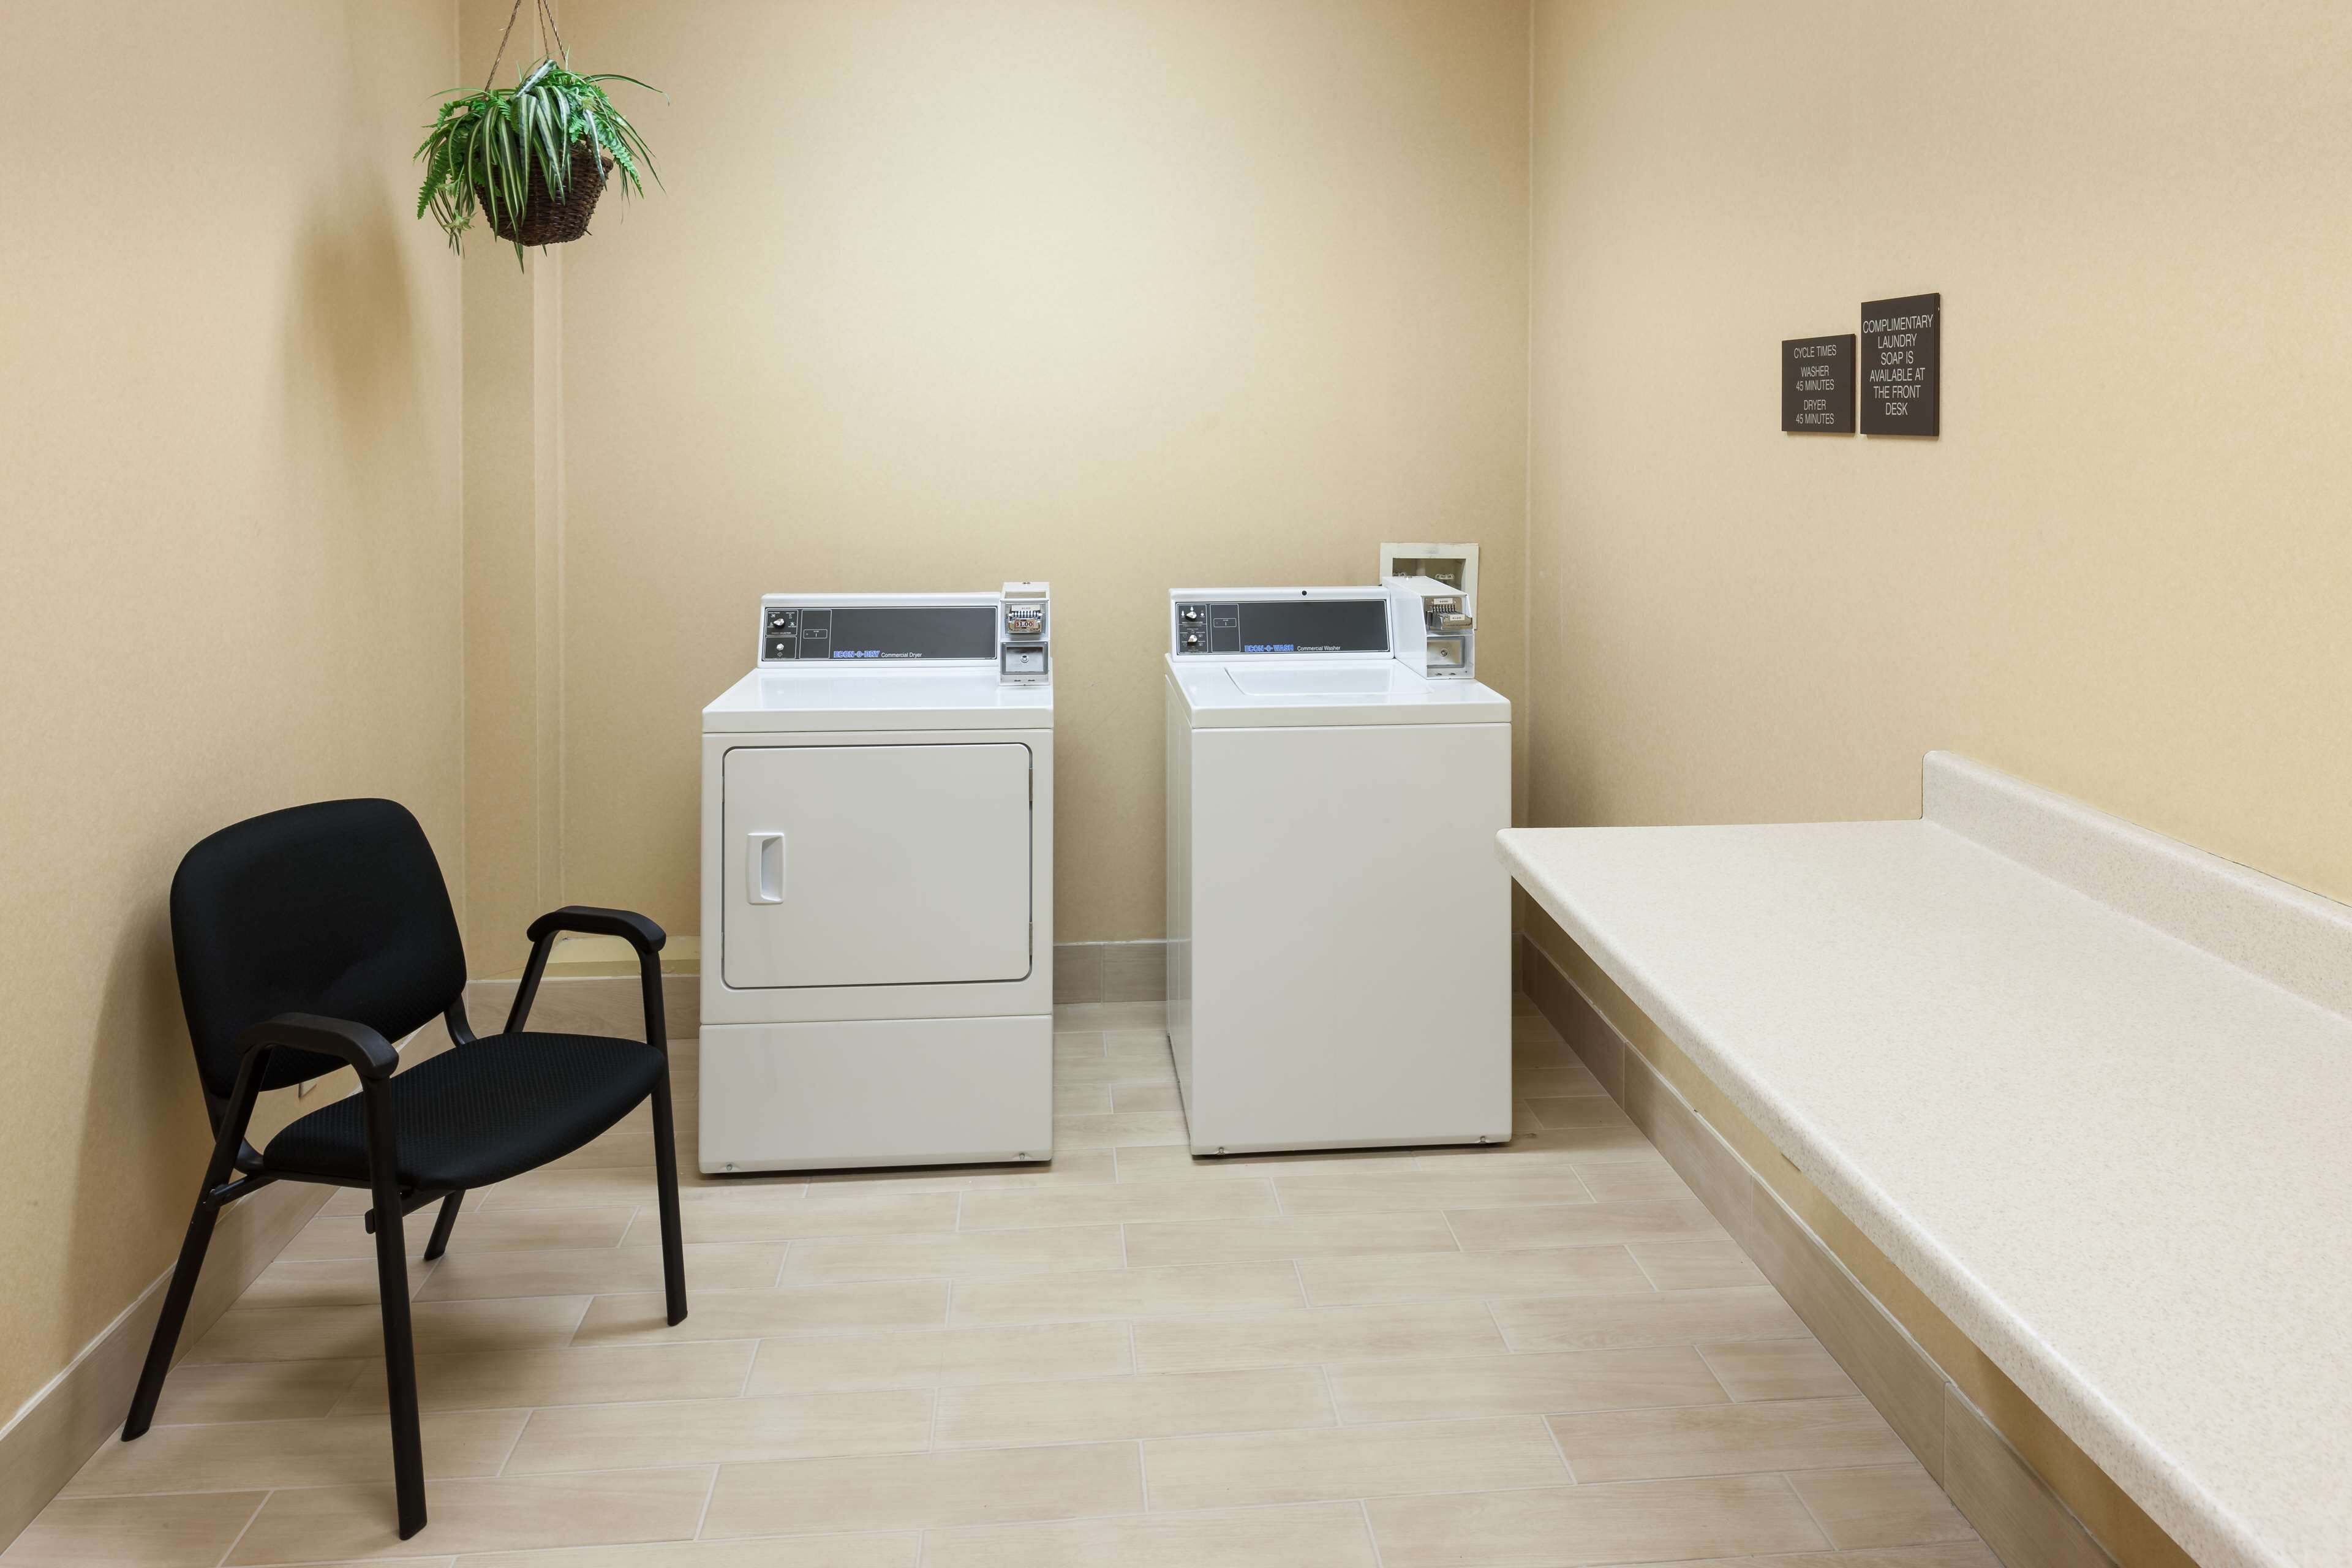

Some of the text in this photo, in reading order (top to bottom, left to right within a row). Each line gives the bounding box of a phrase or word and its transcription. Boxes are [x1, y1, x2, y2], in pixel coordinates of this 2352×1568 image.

[1863, 315, 1933, 333] COMPLIMENTARY
[1878, 334, 1917, 349] LAUNDRY
[1794, 344, 1837, 358] CYCLE TIMES
[1881, 351, 1913, 365] SOAP IS
[1801, 365, 1829, 377] WASHER
[1870, 368, 1926, 382] AVAILABLE AT
[1796, 379, 1834, 391] 45 MINUTES
[1874, 385, 1921, 399] THE FRONT
[1804, 399, 1826, 410] DRYER
[1885, 402, 1908, 415] DESK
[1796, 413, 1834, 424] 45 MINUTES
